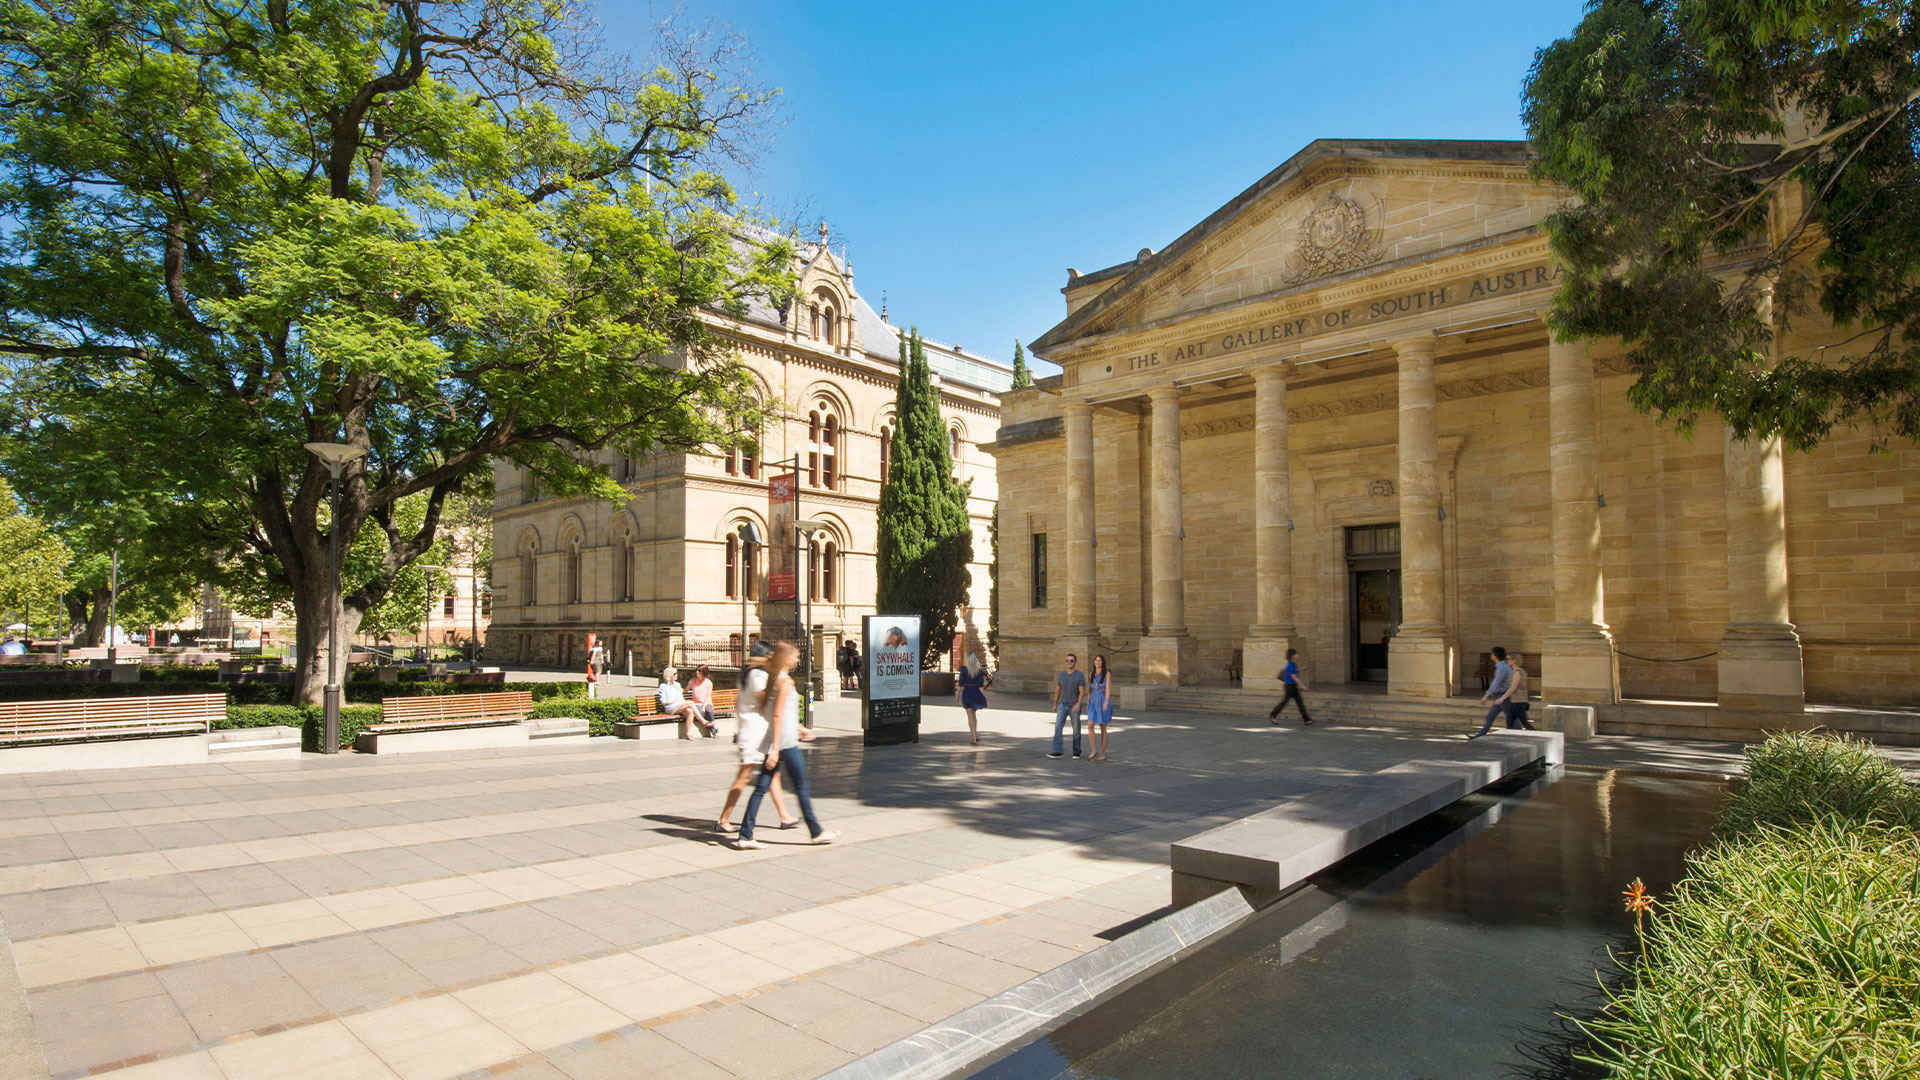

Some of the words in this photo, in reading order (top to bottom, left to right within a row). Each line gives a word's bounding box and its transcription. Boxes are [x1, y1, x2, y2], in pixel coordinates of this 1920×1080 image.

[1128, 352, 1160, 370] THE
[1174, 341, 1206, 360] ART
[1222, 320, 1305, 350] GALLERY
[1324, 309, 1350, 327] OF
[1370, 288, 1446, 318] SOUTH
[876, 652, 915, 664] SKYWHALE
[876, 665, 884, 676] IS
[886, 664, 914, 676] COMING
